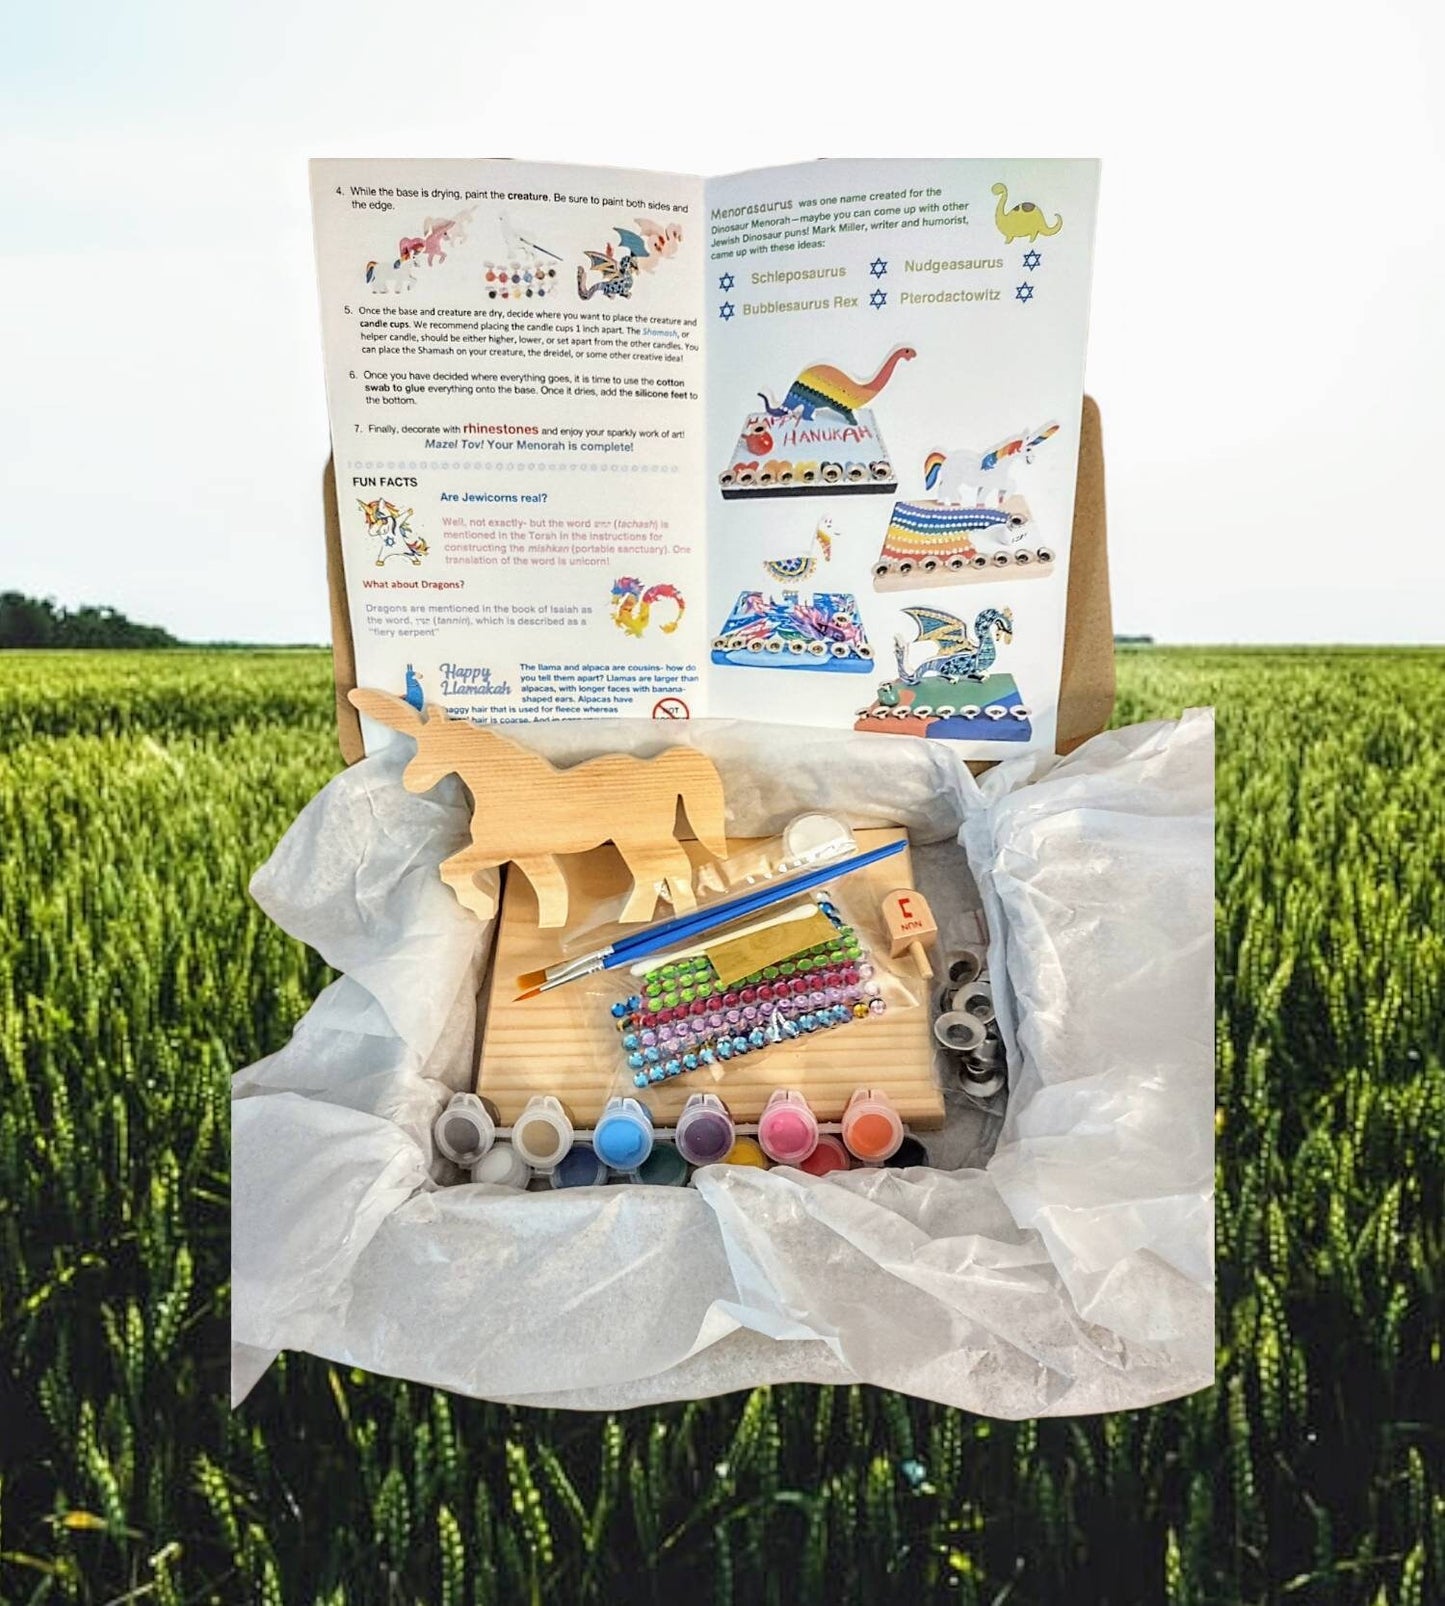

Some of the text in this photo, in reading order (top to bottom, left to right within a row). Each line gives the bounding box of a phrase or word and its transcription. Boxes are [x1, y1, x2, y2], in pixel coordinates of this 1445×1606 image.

[336, 187, 344, 196] 4.
[350, 187, 376, 197] While
[378, 187, 393, 197] the
[395, 188, 418, 197] base
[420, 188, 428, 198] is
[465, 189, 487, 201] paint
[490, 190, 504, 200] the
[553, 193, 566, 202] Be
[568, 196, 588, 204] sure
[590, 195, 599, 205] to
[601, 197, 623, 207] paint
[626, 198, 645, 209] both
[648, 201, 670, 212] sides
[672, 203, 688, 213] and
[352, 200, 395, 212] the edge.
[711, 199, 793, 221] Menorasaurus
[819, 198, 837, 206] one
[839, 196, 866, 204] name
[869, 190, 906, 201] created
[909, 189, 923, 198] for
[925, 188, 941, 197] the
[712, 223, 748, 234] Dinosaur
[833, 212, 851, 222] you
[853, 210, 871, 218] can
[873, 208, 901, 216] come
[903, 207, 916, 216] up
[918, 203, 939, 213] with
[941, 202, 969, 212] other
[711, 215, 969, 247] Jewish Dinosaur puns! Mark Miller, writer and humorist,
[711, 240, 825, 259] came up with these ideas:
[905, 259, 1003, 274] Nudgeasaurus
[752, 267, 847, 283] Schleposaurus
[833, 296, 857, 308] Rex
[901, 289, 1000, 303] Pterodactowitz
[344, 306, 352, 315] 5.
[357, 307, 380, 316] Once
[382, 307, 396, 316] the
[398, 307, 417, 316] base
[419, 308, 435, 316] and
[436, 308, 471, 317] creature
[506, 310, 533, 319] decide
[535, 311, 561, 320] where
[562, 313, 578, 322] you
[579, 313, 599, 321] want
[602, 313, 610, 321] to
[612, 313, 632, 324] place
[634, 314, 647, 323] the
[649, 316, 681, 325] creature
[683, 318, 697, 326] and
[363, 371, 388, 380] Once
[389, 373, 407, 382] you
[408, 372, 430, 380] have
[432, 372, 468, 381] decided
[470, 372, 498, 381] where
[500, 373, 545, 384] everything
[574, 375, 579, 383] it
[581, 375, 589, 383] is
[591, 375, 610, 384] time
[612, 376, 621, 384] to
[640, 376, 654, 385] the
[656, 377, 685, 386] cotton
[366, 395, 416, 405] the bottom.
[401, 425, 440, 434] decorate
[442, 425, 461, 434] with
[463, 423, 538, 435] rhinestones
[542, 427, 558, 435] and
[559, 429, 583, 438] enjoy
[585, 429, 604, 438] your
[606, 428, 636, 439] sparkly
[638, 429, 659, 437] work
[661, 429, 669, 438] of
[783, 425, 873, 446] HANUKAH
[425, 439, 634, 453] Mazel Tov! Your Menorah is complete!
[353, 477, 418, 487] FUN FACTS
[440, 493, 547, 503] Are Jewicorns real?
[363, 580, 465, 590] What about Dragons?
[439, 663, 491, 683] Happy
[520, 663, 535, 671] The
[537, 663, 561, 671] llama
[581, 664, 609, 673] alpaca
[576, 674, 604, 683] apart?
[606, 674, 636, 682] Llamas
[653, 674, 678, 683] larger
[680, 674, 699, 682] than
[440, 680, 512, 696] Llamakah
[578, 685, 605, 694] longer
[607, 685, 630, 693] faces
[632, 685, 649, 693] with
[522, 695, 552, 705] shaped
[577, 695, 611, 705] Alpacas
[471, 716, 488, 724] hair
[489, 716, 497, 724] is
[901, 921, 923, 931] NUN
